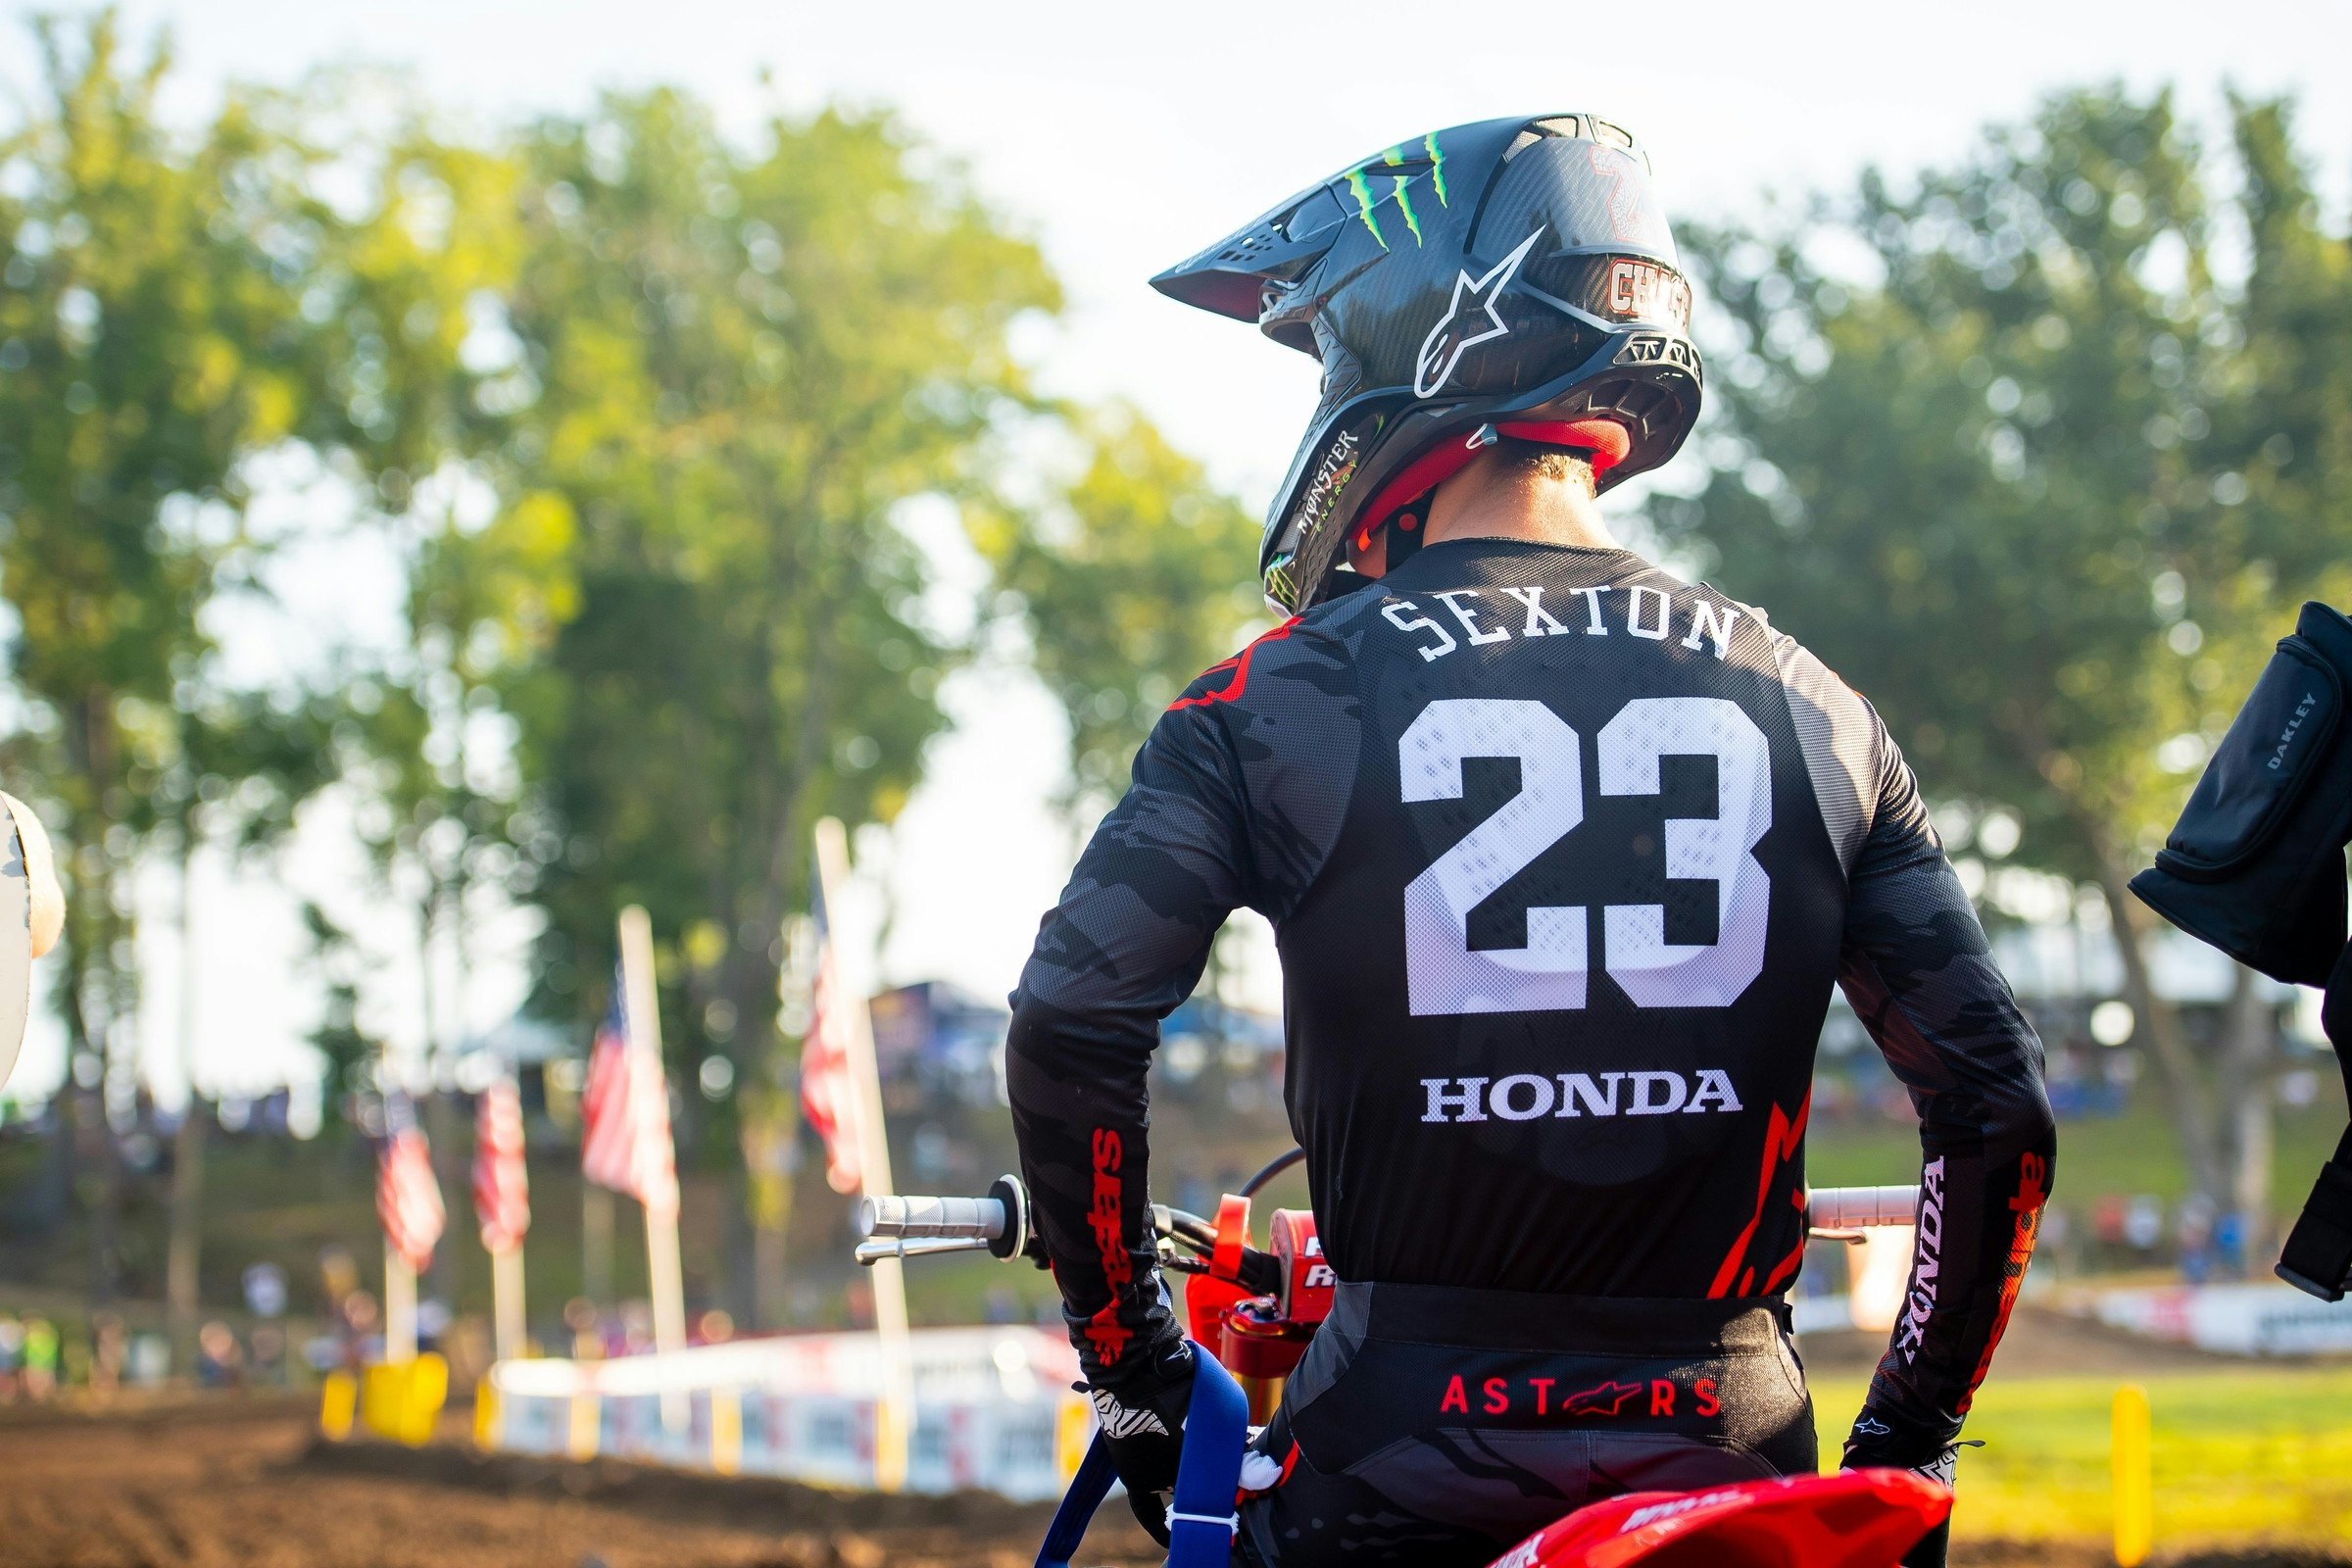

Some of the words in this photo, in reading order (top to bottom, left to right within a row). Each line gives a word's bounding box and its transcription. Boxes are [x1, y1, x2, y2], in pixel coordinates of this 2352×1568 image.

[1297, 430, 1358, 535] MONSTER
[1315, 458, 1358, 533] ENERGY
[1381, 584, 1740, 663] SEXTON
[2267, 692, 2317, 770] OAKLEY
[1397, 696, 1773, 1016] 23
[1420, 1069, 1744, 1124] HONDA
[1084, 1127, 1134, 1367] alpnestars
[1896, 1155, 1945, 1366] HONDA
